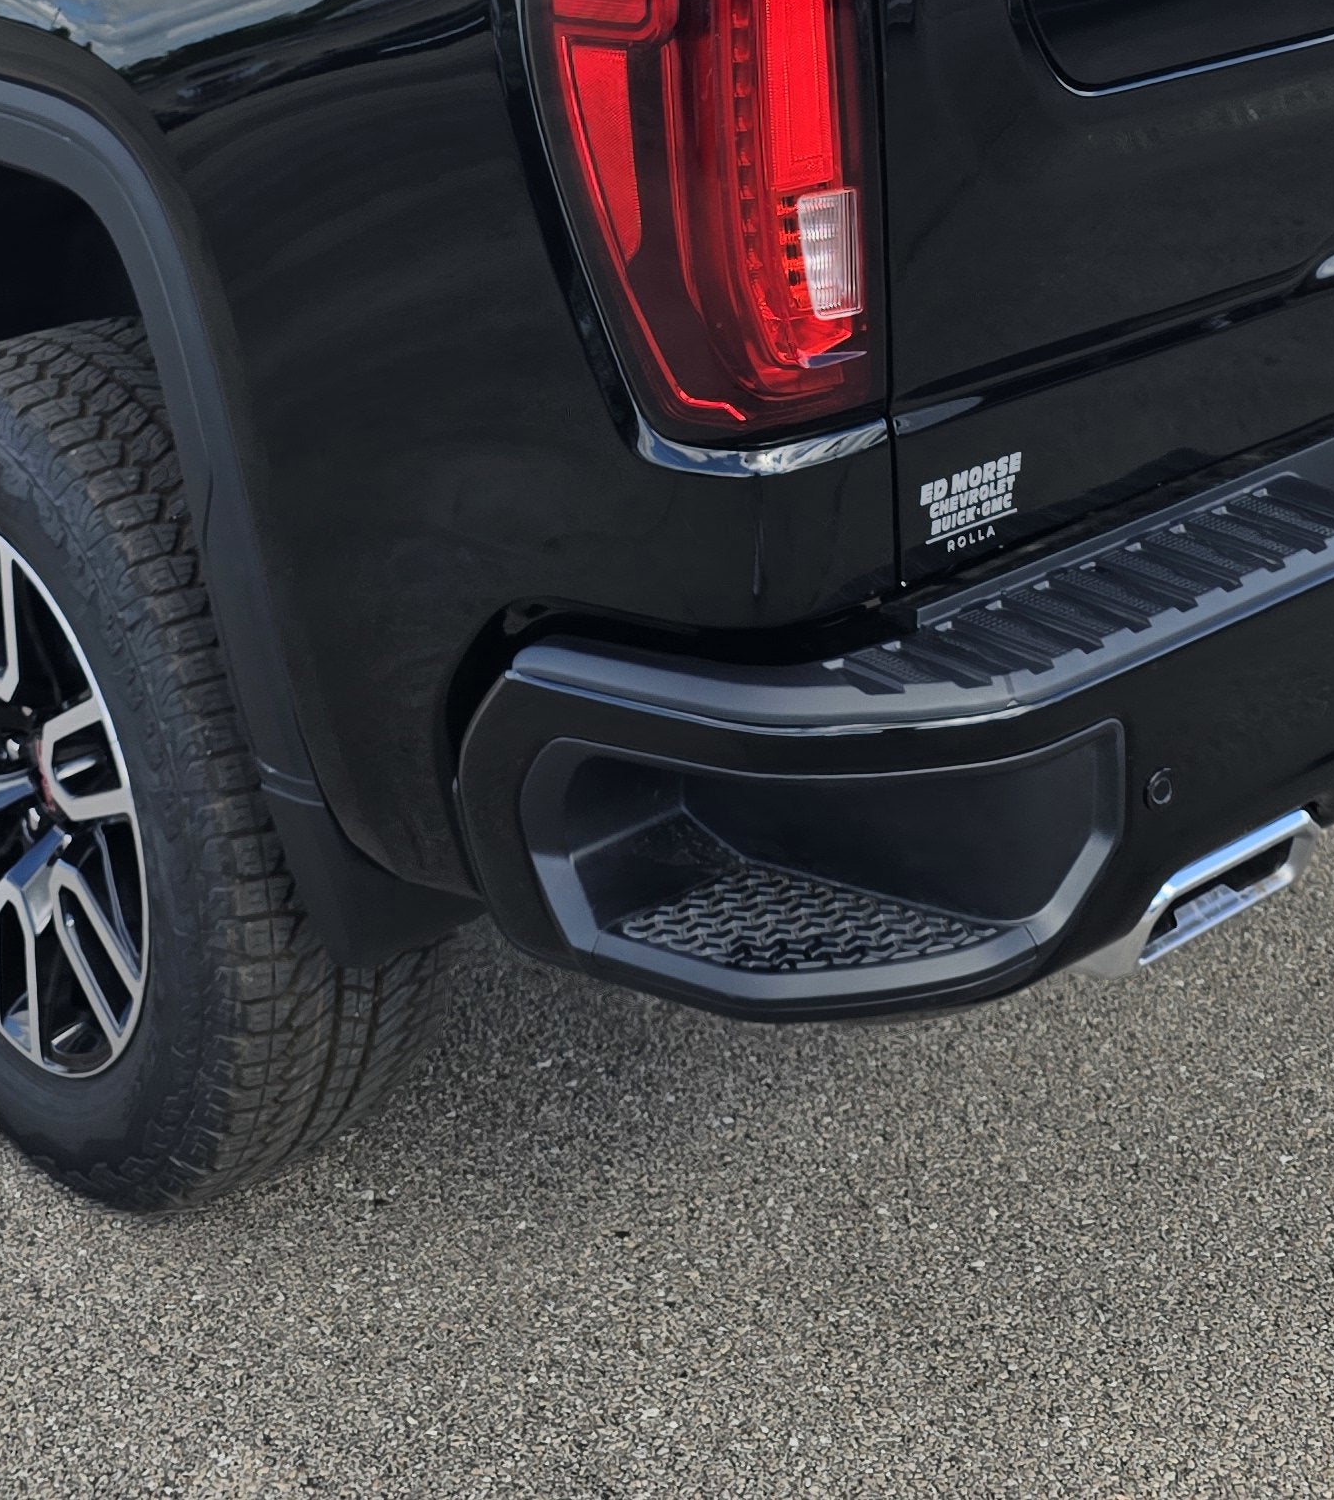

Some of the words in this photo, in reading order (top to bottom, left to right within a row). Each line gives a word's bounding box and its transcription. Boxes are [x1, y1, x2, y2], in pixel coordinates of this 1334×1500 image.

[920, 478, 949, 506] ED
[951, 452, 1022, 494] MORSE
[930, 474, 1016, 519] CHEVROLET
[947, 525, 995, 553] ROLLA
